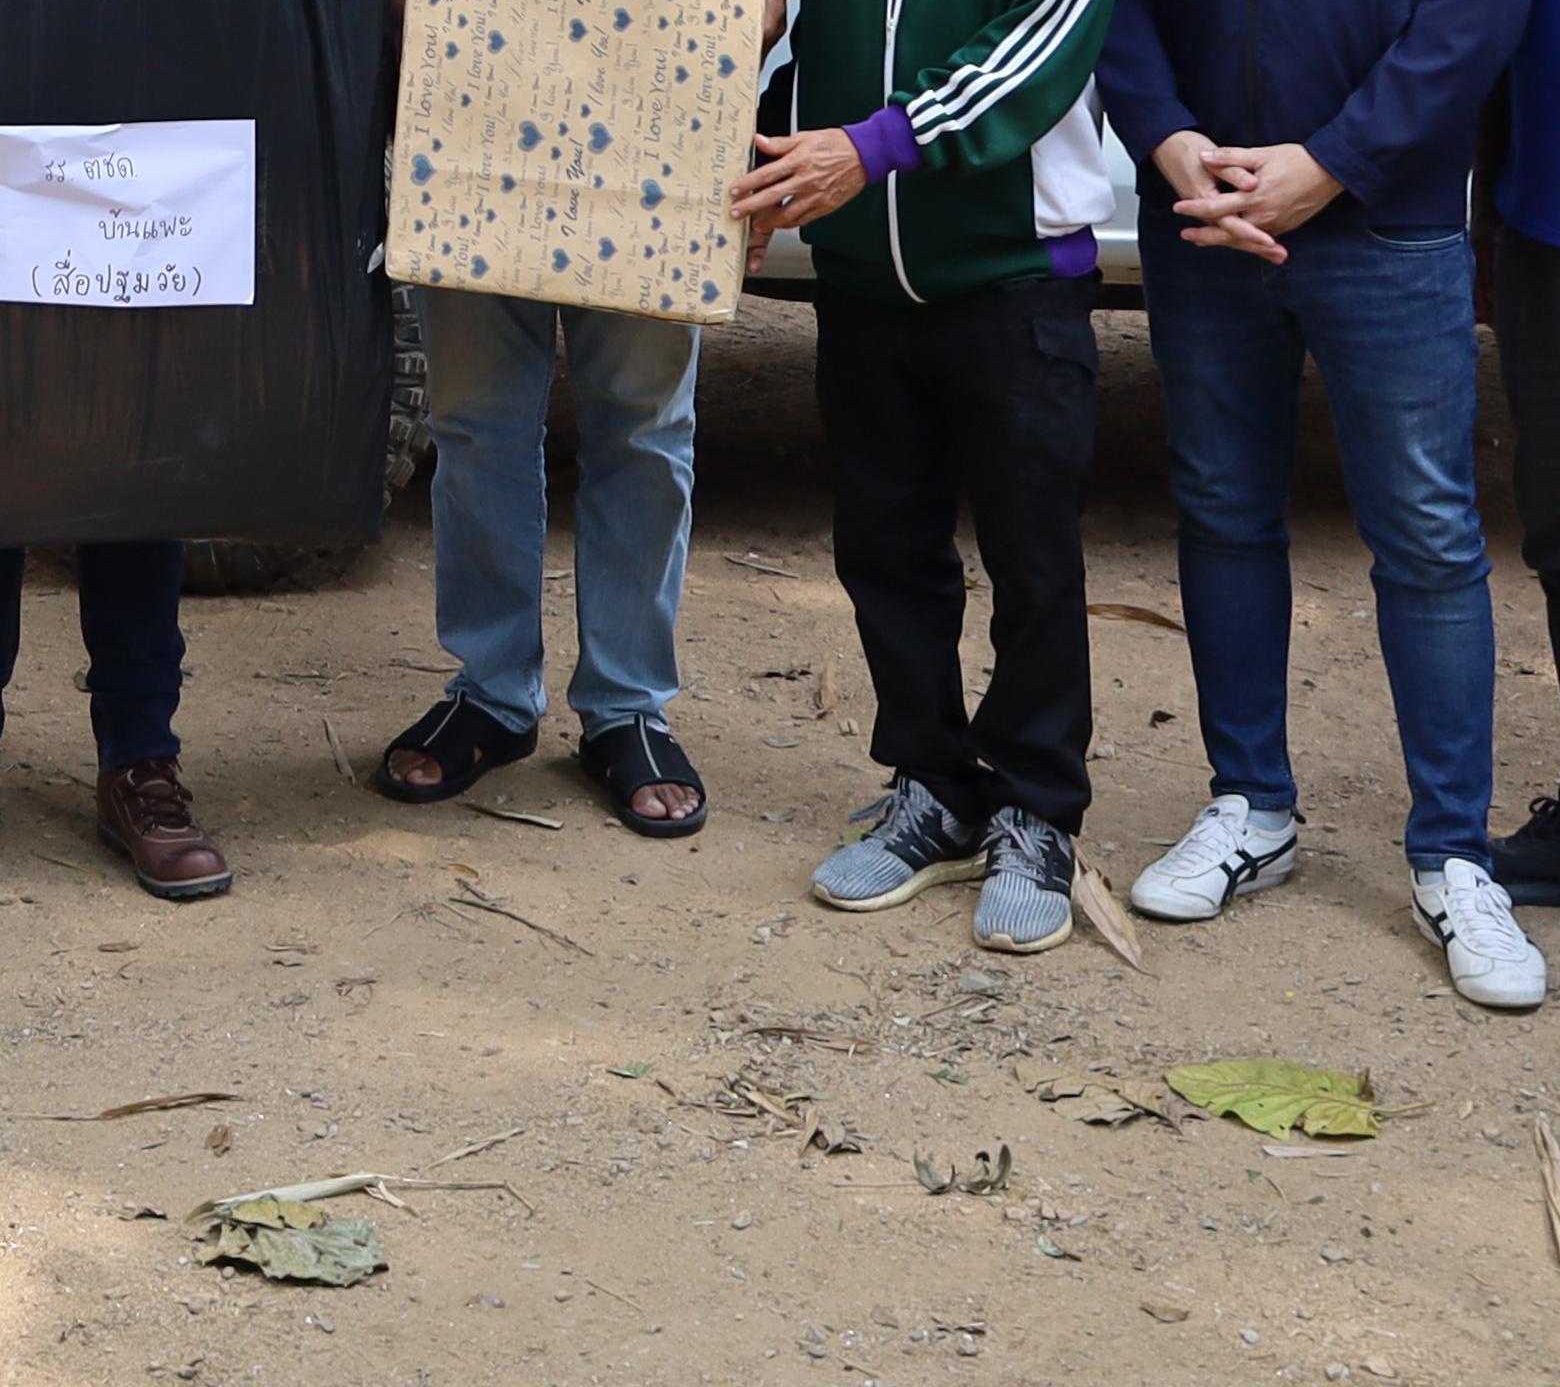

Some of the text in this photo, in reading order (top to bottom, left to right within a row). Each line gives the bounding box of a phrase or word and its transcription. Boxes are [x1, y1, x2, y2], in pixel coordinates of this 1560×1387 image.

[470, 9, 490, 45] You!
[414, 24, 439, 136] I love You!
[466, 48, 484, 79] love
[584, 25, 610, 107] I love You!
[695, 34, 719, 115] I love You!
[467, 82, 481, 91] I
[643, 48, 668, 161] I love You!
[480, 113, 499, 147] You!
[475, 152, 493, 182] love
[706, 138, 729, 217] I love You!
[476, 184, 490, 193] I
[560, 137, 590, 237] I love You!
[408, 249, 422, 282] ou!
[637, 274, 653, 310] ou!
